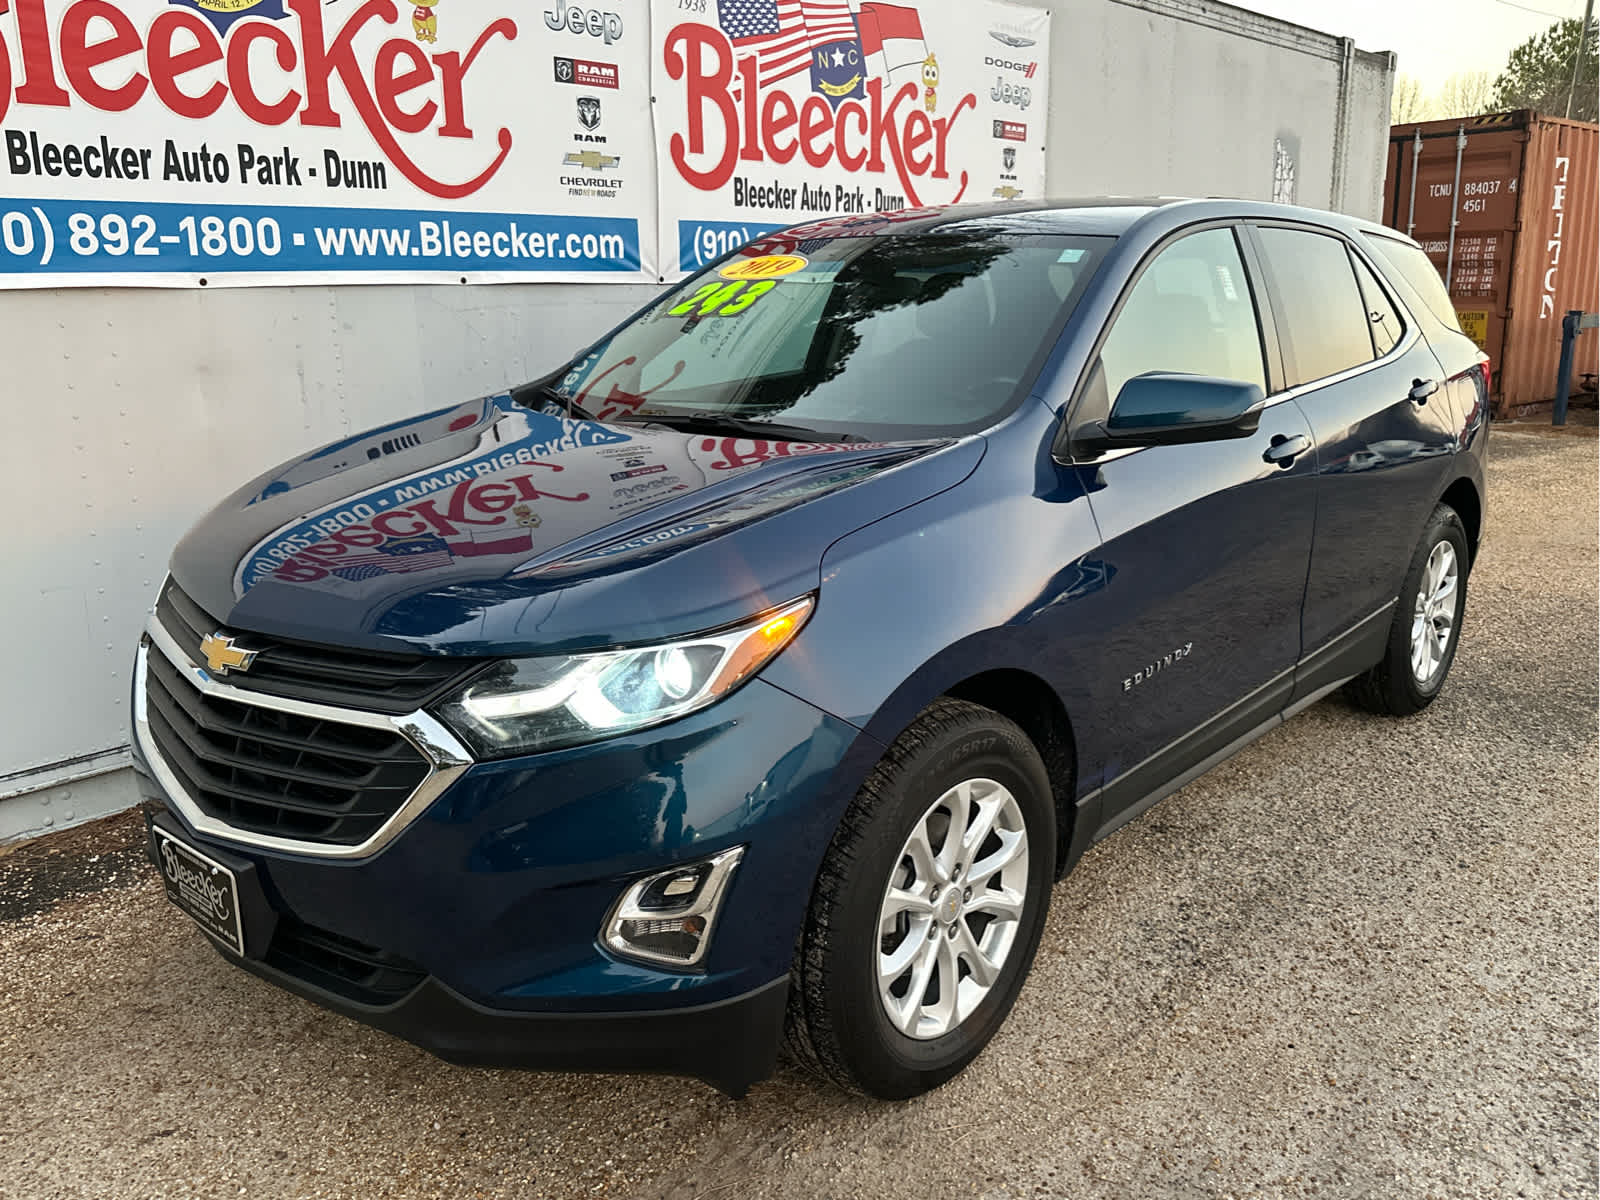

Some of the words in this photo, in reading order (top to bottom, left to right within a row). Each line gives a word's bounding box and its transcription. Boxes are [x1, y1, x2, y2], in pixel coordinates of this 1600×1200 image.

[544, 0, 623, 45] Jeep
[577, 64, 615, 77] RAM
[818, 51, 829, 68] N
[848, 49, 859, 66] C
[984, 56, 1033, 74] DODGE
[0, 0, 518, 199] leecker
[991, 76, 1032, 111] Jeep
[664, 22, 976, 207] Bleecker
[574, 133, 608, 144] RAM
[5, 129, 152, 180] Bleecker
[163, 139, 230, 184] Auto
[237, 143, 303, 187] Park
[324, 149, 388, 190] Dunn
[560, 176, 624, 189] CHEVROLET
[734, 176, 798, 211] Bleecker
[800, 182, 831, 213] Auto
[835, 185, 864, 213] Park
[876, 188, 904, 212] Dunn
[1430, 183, 1452, 197] TCNU
[1464, 180, 1501, 196] 884037
[1508, 178, 1517, 193] 4
[0, 206, 54, 265] 0)
[67, 211, 282, 258] 892-1800
[314, 220, 625, 260] www.Bleecker.com
[668, 280, 776, 316] 243
[1122, 641, 1193, 692] EQUINOX
[161, 843, 230, 921] Bleecker
